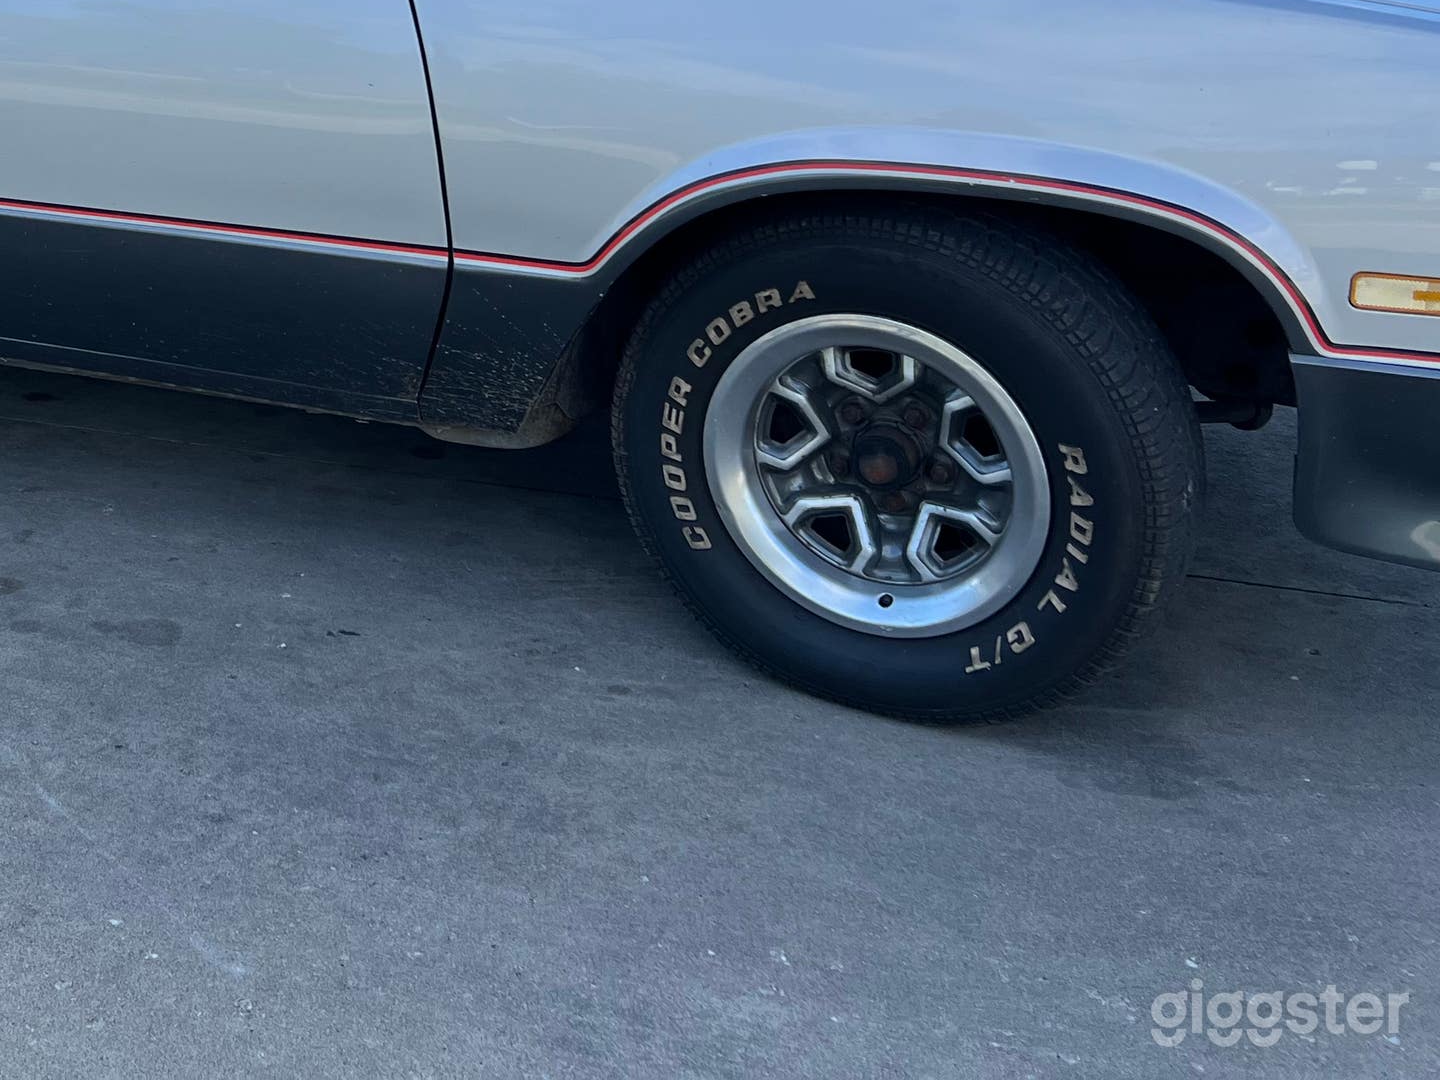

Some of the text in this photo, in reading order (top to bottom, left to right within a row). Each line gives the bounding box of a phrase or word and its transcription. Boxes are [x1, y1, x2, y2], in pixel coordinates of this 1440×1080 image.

[661, 279, 817, 552] COOPER COBRA
[964, 442, 1095, 674] RADIAL G/T
